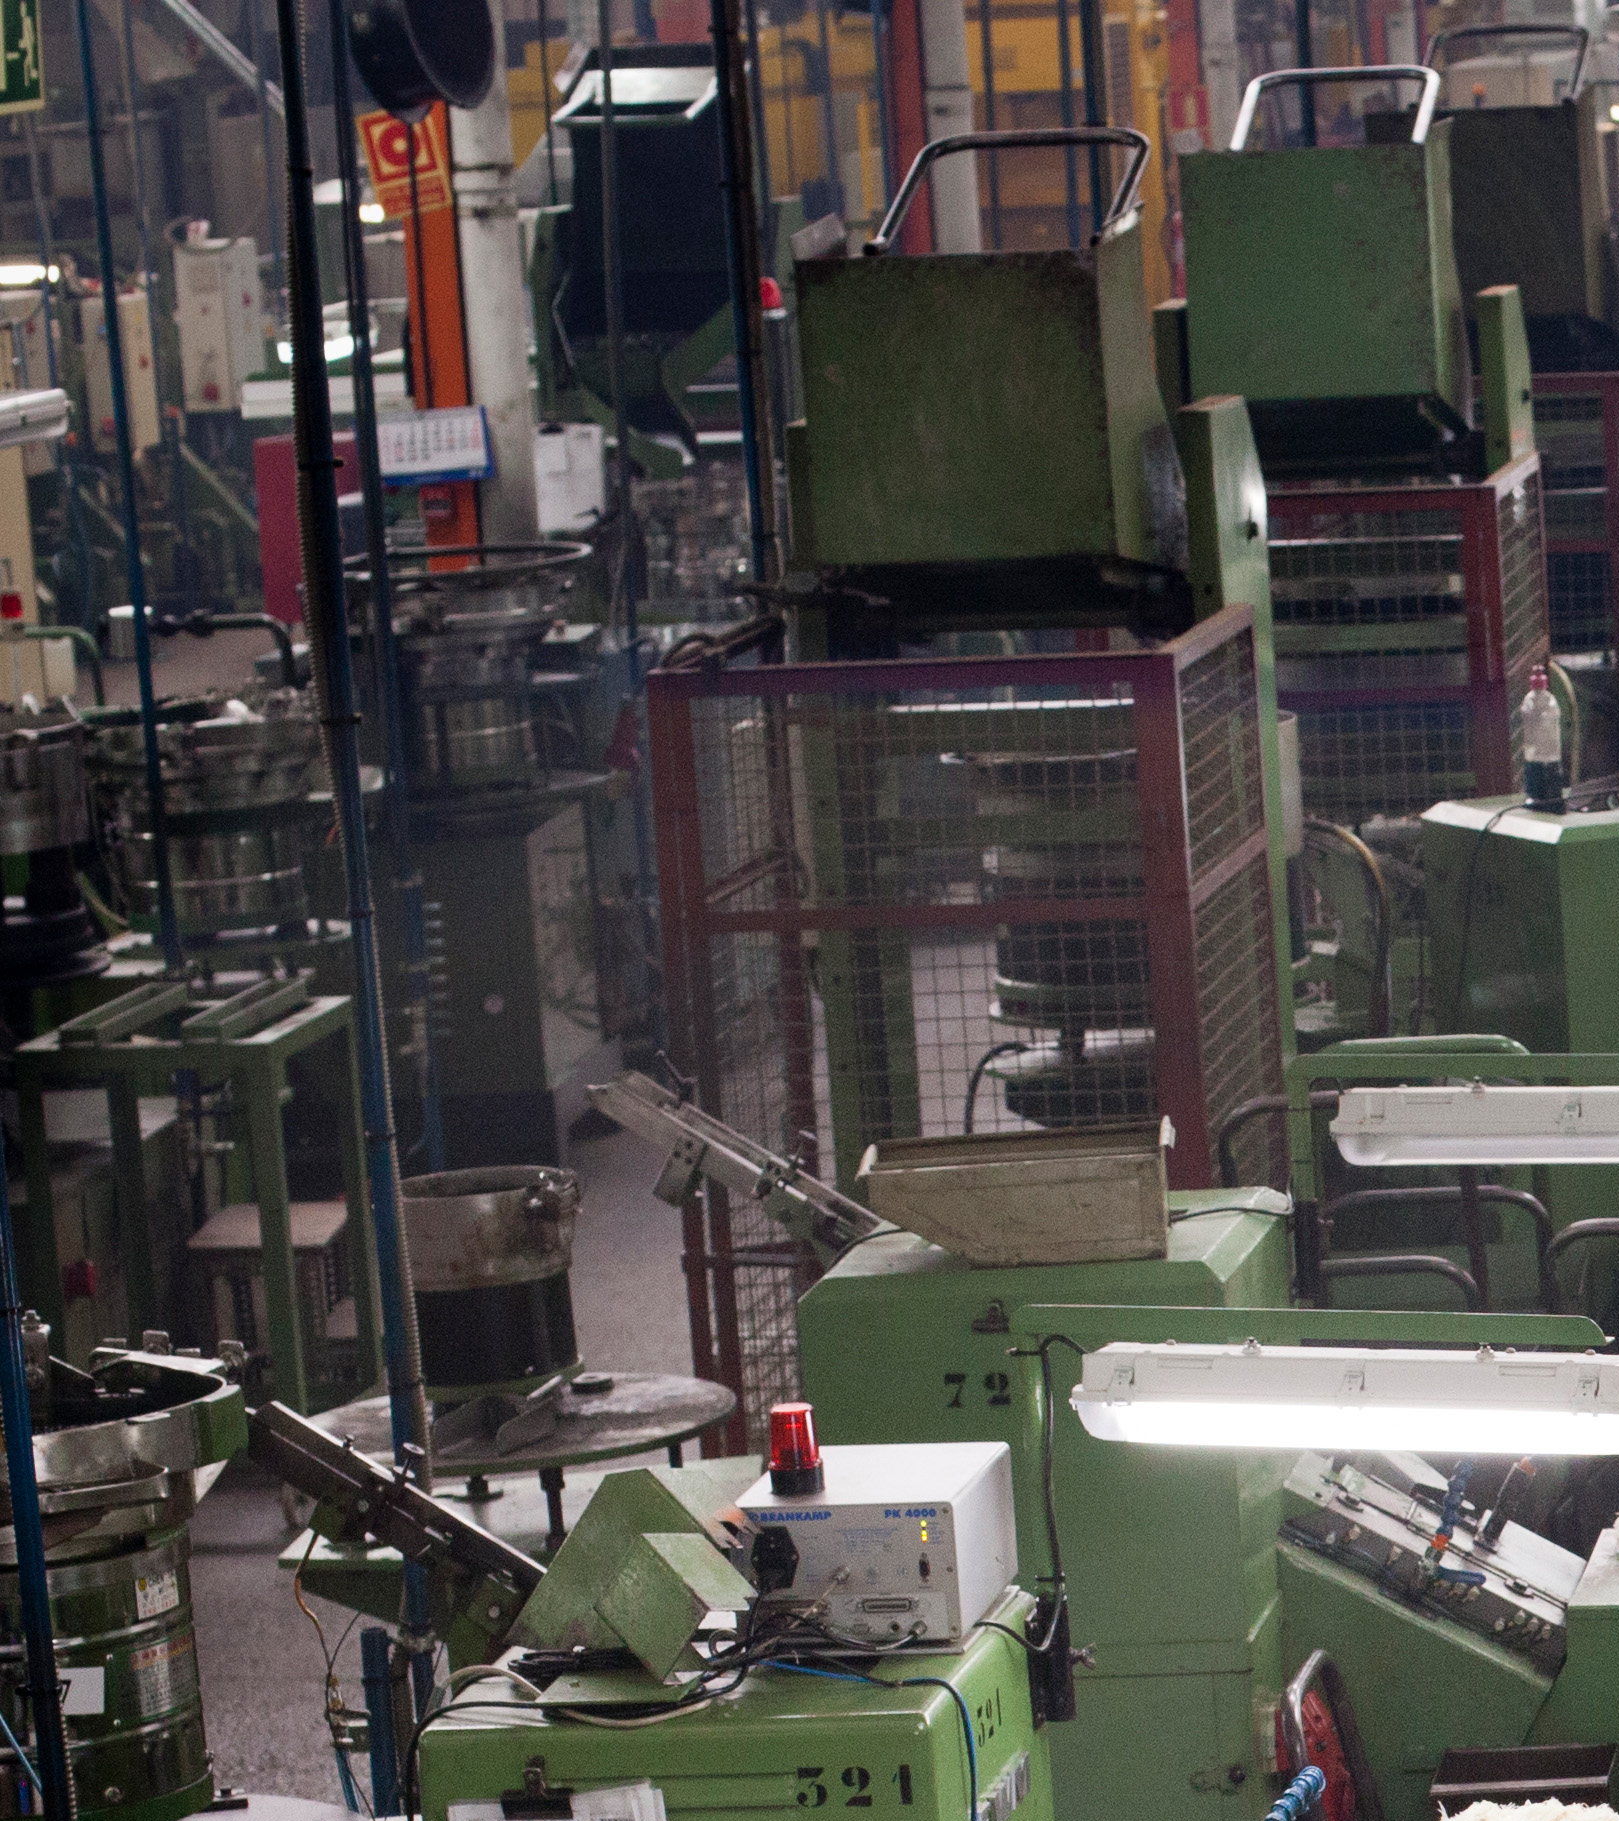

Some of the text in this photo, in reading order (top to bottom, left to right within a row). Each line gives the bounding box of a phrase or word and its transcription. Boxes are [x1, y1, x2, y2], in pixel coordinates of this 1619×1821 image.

[760, 1507, 937, 1522] BRANKAMP PK 4000
[976, 1686, 1003, 1748] 321
[796, 1764, 914, 1808] 321
